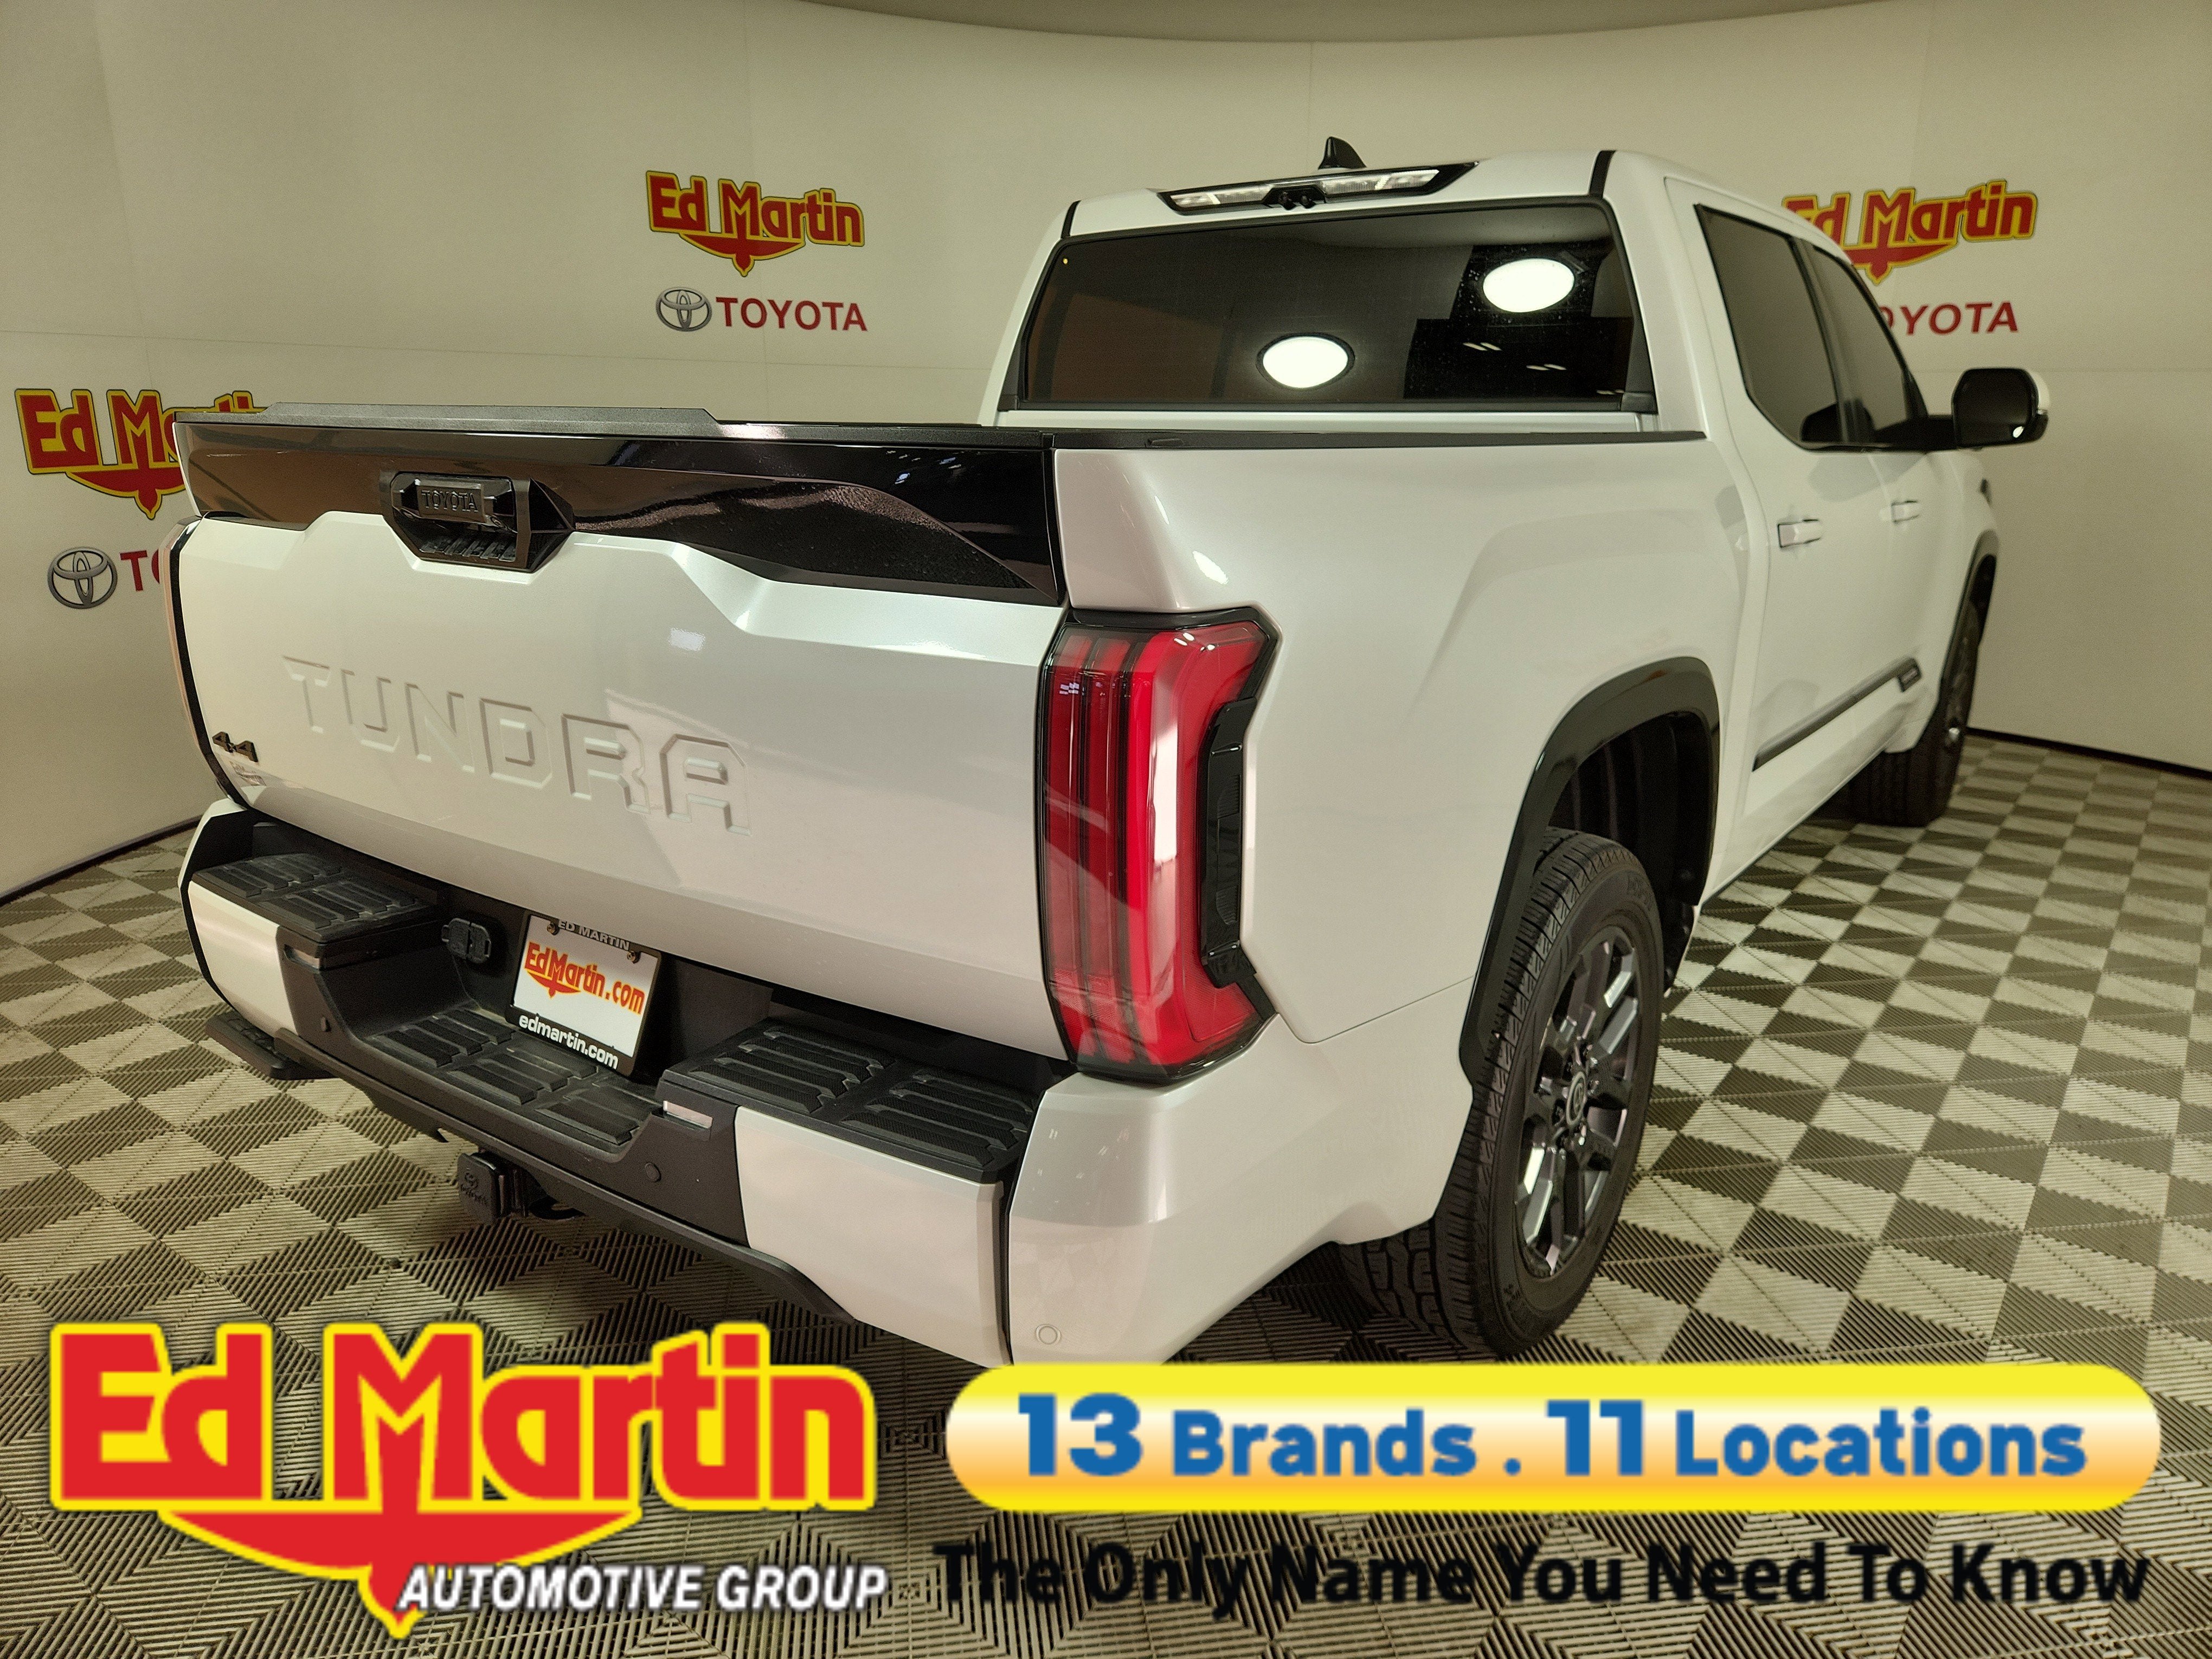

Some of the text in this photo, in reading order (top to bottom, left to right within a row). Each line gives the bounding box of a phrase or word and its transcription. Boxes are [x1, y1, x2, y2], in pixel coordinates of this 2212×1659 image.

[646, 171, 865, 247] Ed Martin
[1863, 179, 2037, 245] Martin
[716, 297, 867, 332] TOYOTA
[15, 388, 101, 474] Ed
[421, 490, 478, 513] TOYOTA
[281, 655, 753, 836] TUNDRA
[557, 920, 630, 951] ED MARTIN
[518, 1014, 619, 1070] edmartin.com
